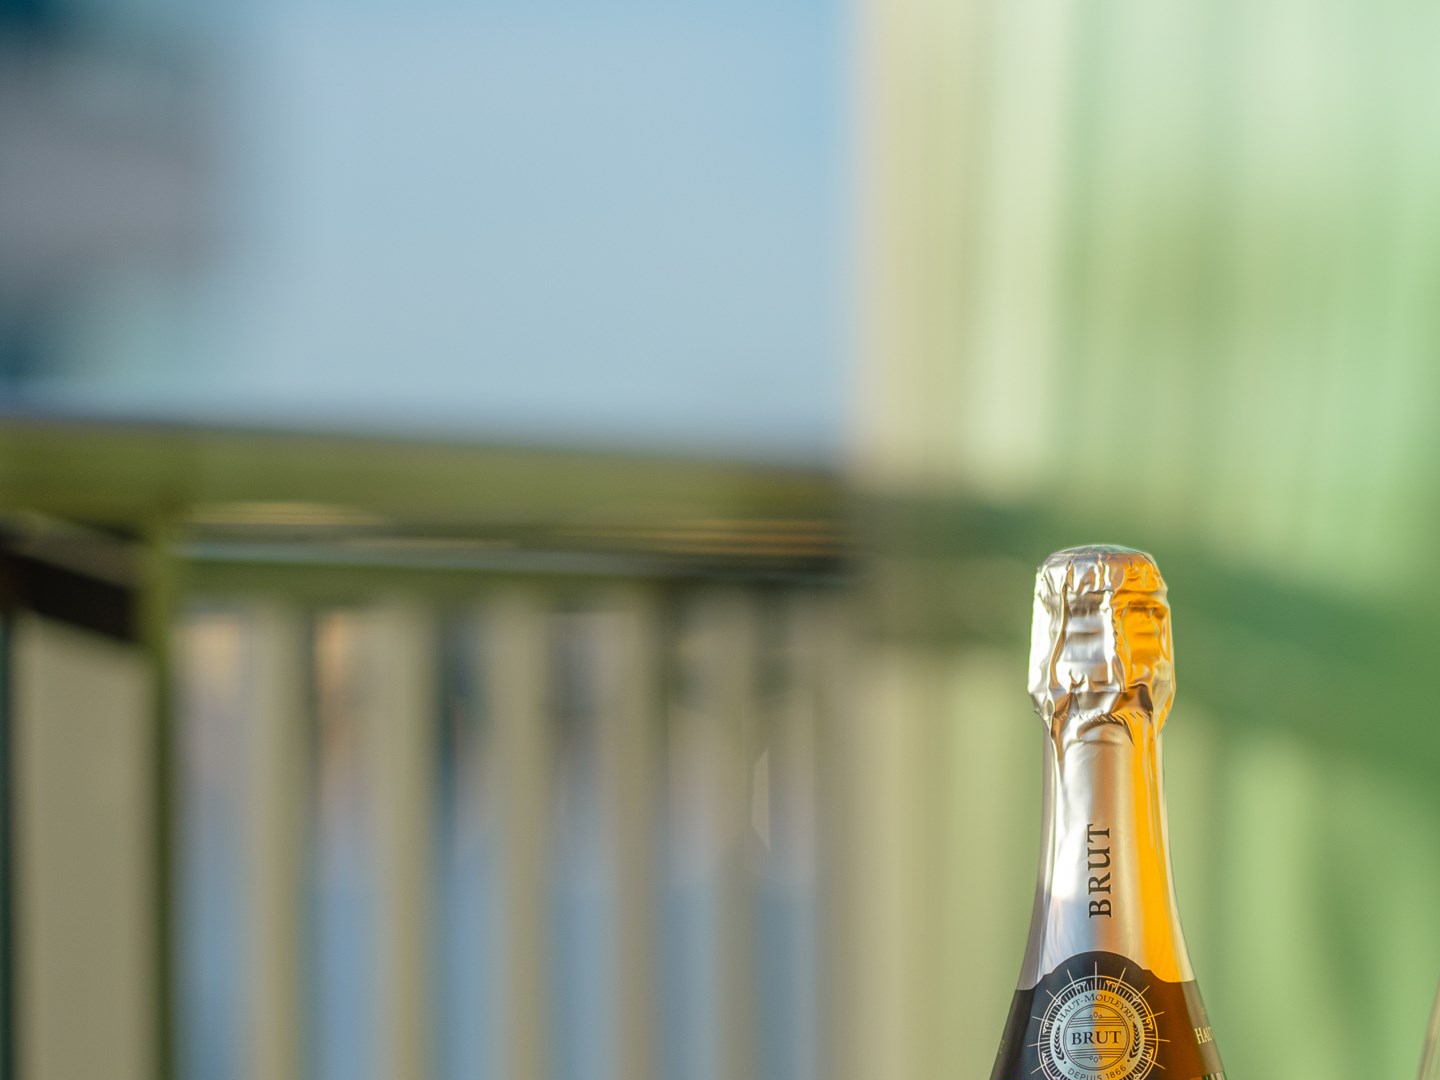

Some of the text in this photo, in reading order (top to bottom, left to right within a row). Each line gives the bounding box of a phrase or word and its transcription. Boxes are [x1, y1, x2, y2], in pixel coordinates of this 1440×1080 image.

[1087, 823, 1112, 918] BRUT
[1057, 993, 1136, 1023] HAUT-MOULEYRE
[1071, 1030, 1121, 1045] BRUT
[1106, 1064, 1127, 1080] 1866
